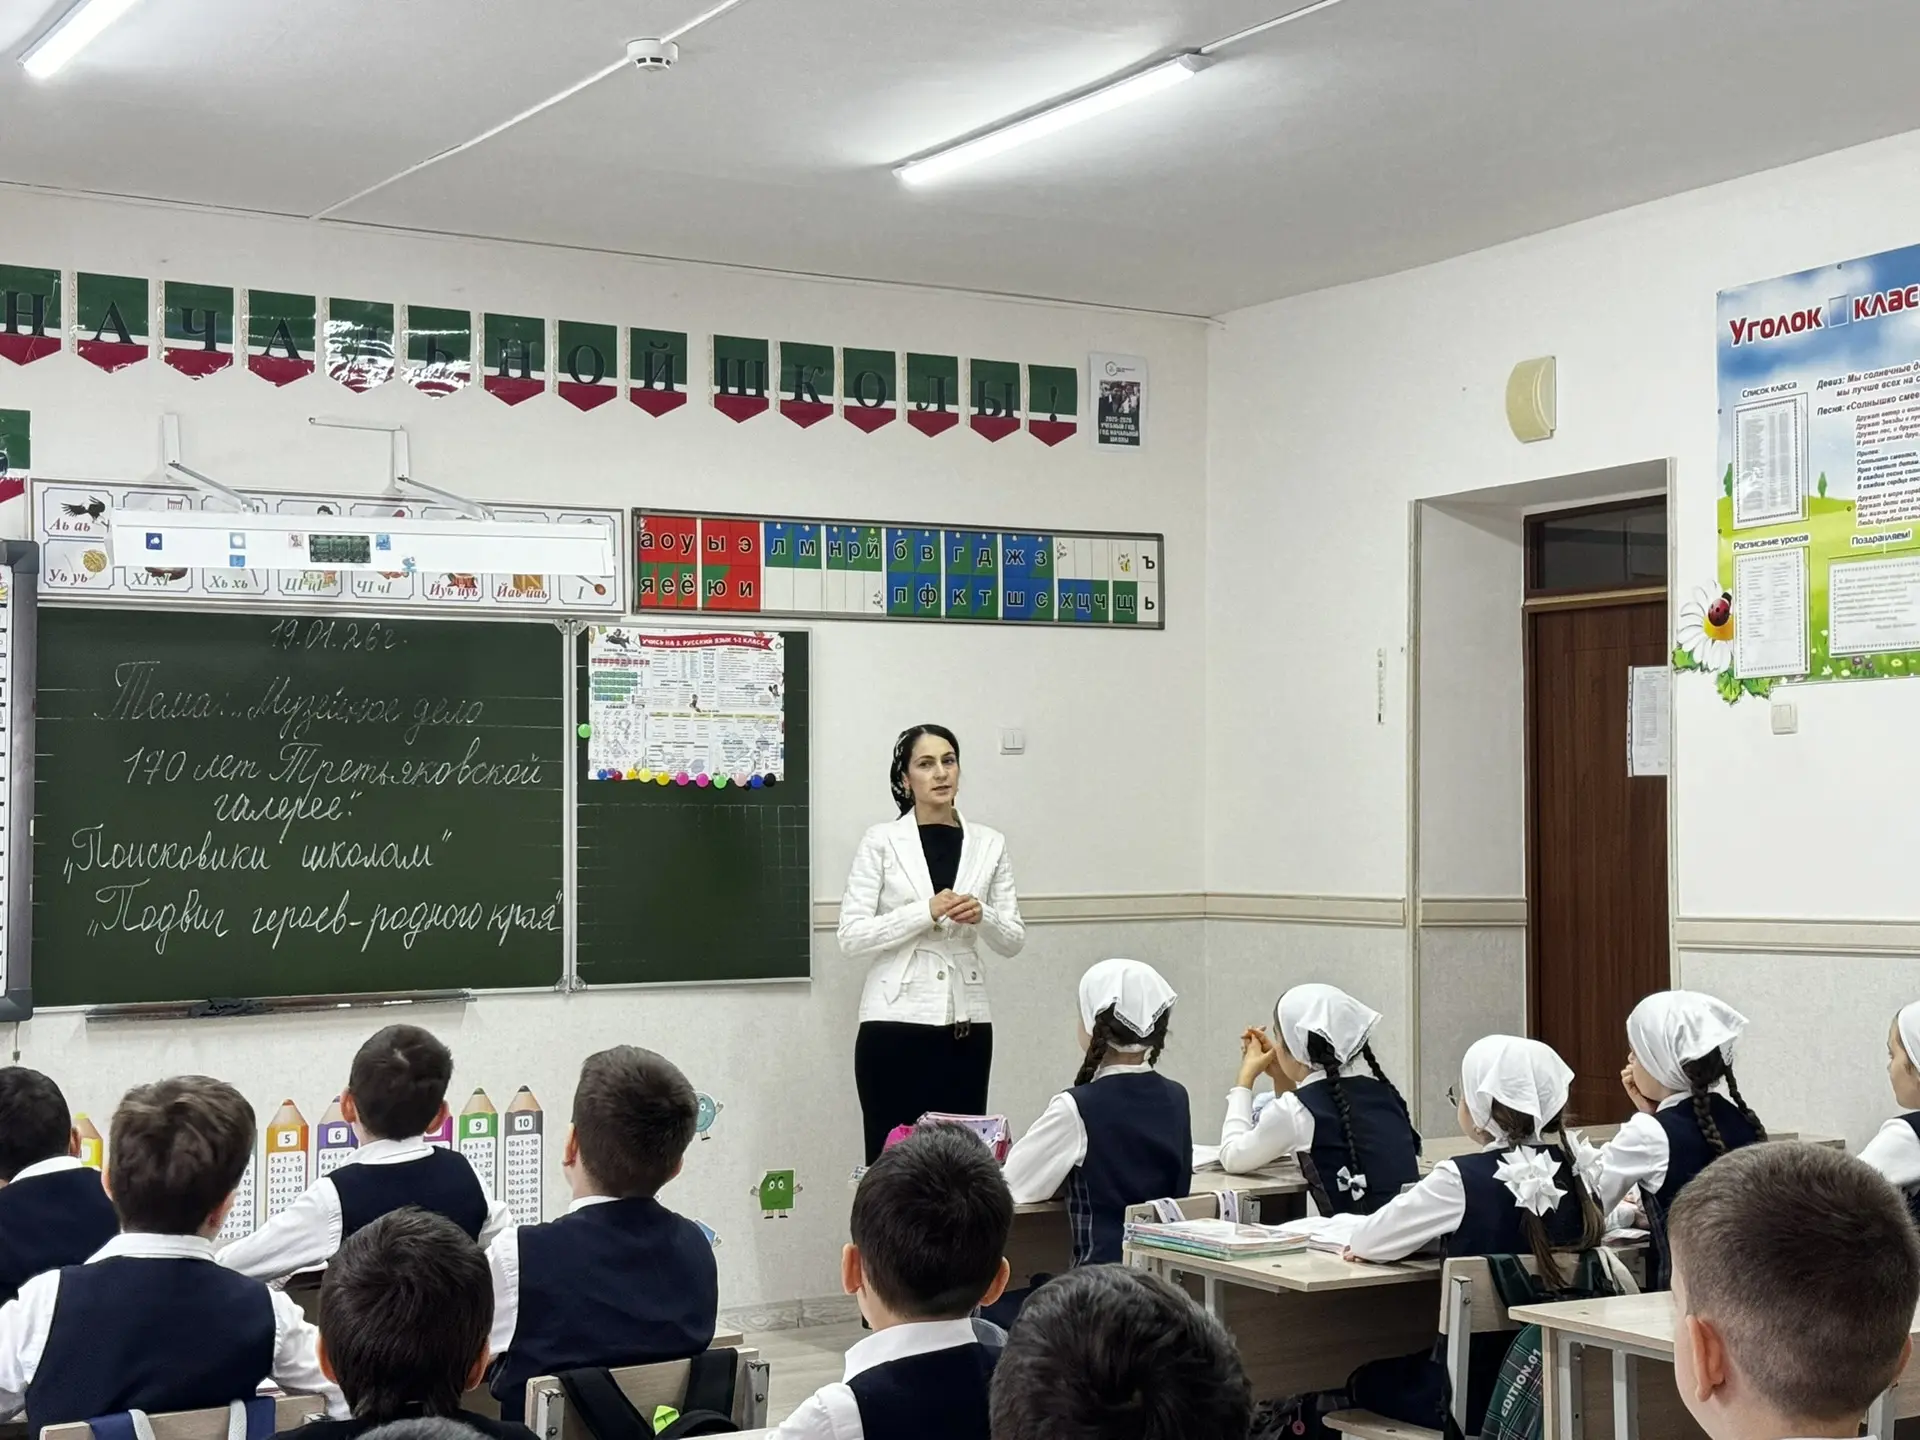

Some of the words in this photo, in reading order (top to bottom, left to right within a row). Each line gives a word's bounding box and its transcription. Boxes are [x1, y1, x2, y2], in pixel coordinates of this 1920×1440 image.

[1729, 307, 1822, 345] Уголок
[1816, 377, 1845, 390] Девиз:
[1847, 373, 1861, 383] Мы
[1863, 365, 1911, 380] солнечные
[1742, 386, 1770, 398] Список
[1771, 381, 1797, 392] класса
[1836, 388, 1850, 397] мы
[1852, 383, 1879, 395] лучше
[1881, 378, 1901, 389] всех
[1903, 376, 1913, 385] на
[1817, 405, 1845, 415] Песня:
[50, 517, 69, 531] Аь
[74, 519, 91, 532] аь
[1734, 537, 1779, 550] Расписание
[1781, 534, 1809, 546] уроков
[1851, 530, 1911, 545] Поздравляем!
[49, 569, 67, 583] Уь
[70, 571, 88, 585] уь
[210, 575, 228, 589] Хь
[232, 577, 248, 589] хь
[683, 637, 713, 646] РУССКИЙ
[743, 638, 765, 646] КЛАСС
[405, 696, 484, 746] дело
[124, 746, 187, 785] 170
[193, 754, 262, 782] лет
[269, 736, 542, 797] Третьяковской
[475, 1121, 481, 1131] 9
[518, 1118, 529, 1128] 10
[284, 1134, 291, 1143] 5
[334, 1130, 341, 1140] 6
[1500, 1348, 1542, 1418] EDITION.01
